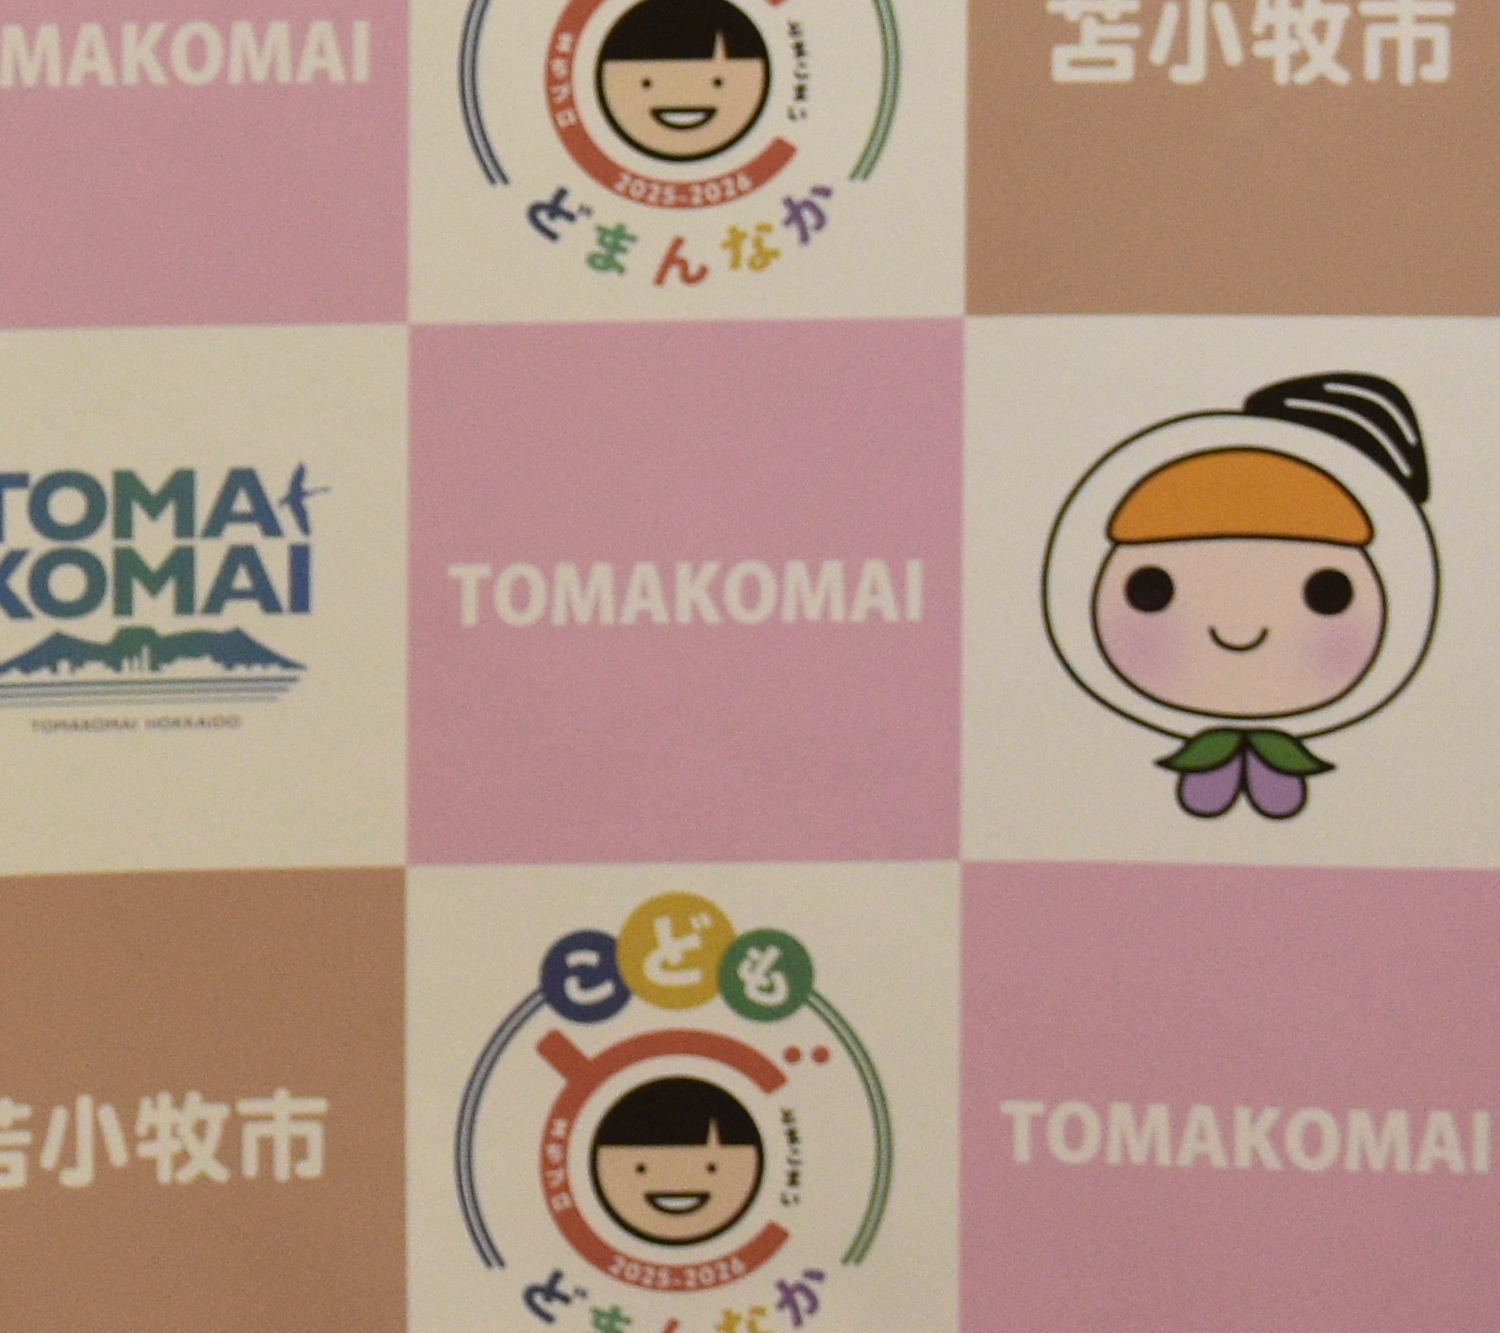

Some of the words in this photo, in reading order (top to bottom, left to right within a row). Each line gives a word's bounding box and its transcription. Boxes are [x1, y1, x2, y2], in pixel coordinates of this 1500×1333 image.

[613, 171, 753, 207] 2025-2026
[525, 184, 832, 287] どまんなか
[448, 558, 924, 627] TOMAKOMAI
[564, 912, 790, 1004] こども
[1000, 1100, 1491, 1173] TOMAKOMAI
[607, 1254, 747, 1290] 2025-2026
